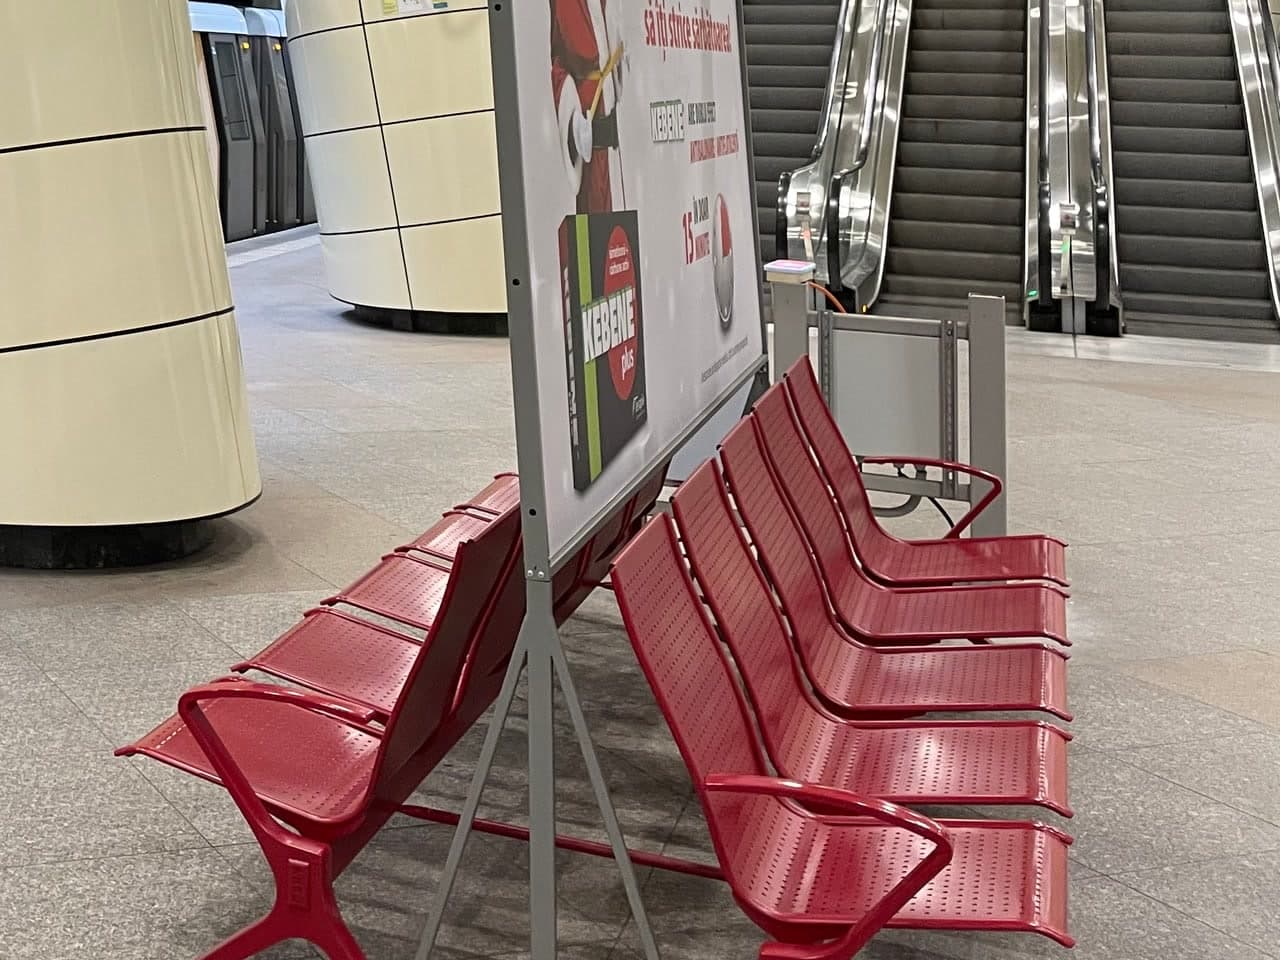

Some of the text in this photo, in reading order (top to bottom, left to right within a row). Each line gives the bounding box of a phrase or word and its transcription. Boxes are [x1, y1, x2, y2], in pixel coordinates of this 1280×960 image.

[650, 99, 685, 144] KEBENE
[682, 211, 694, 265] 15
[582, 287, 635, 363] KEBENE
[621, 348, 634, 381] plus
